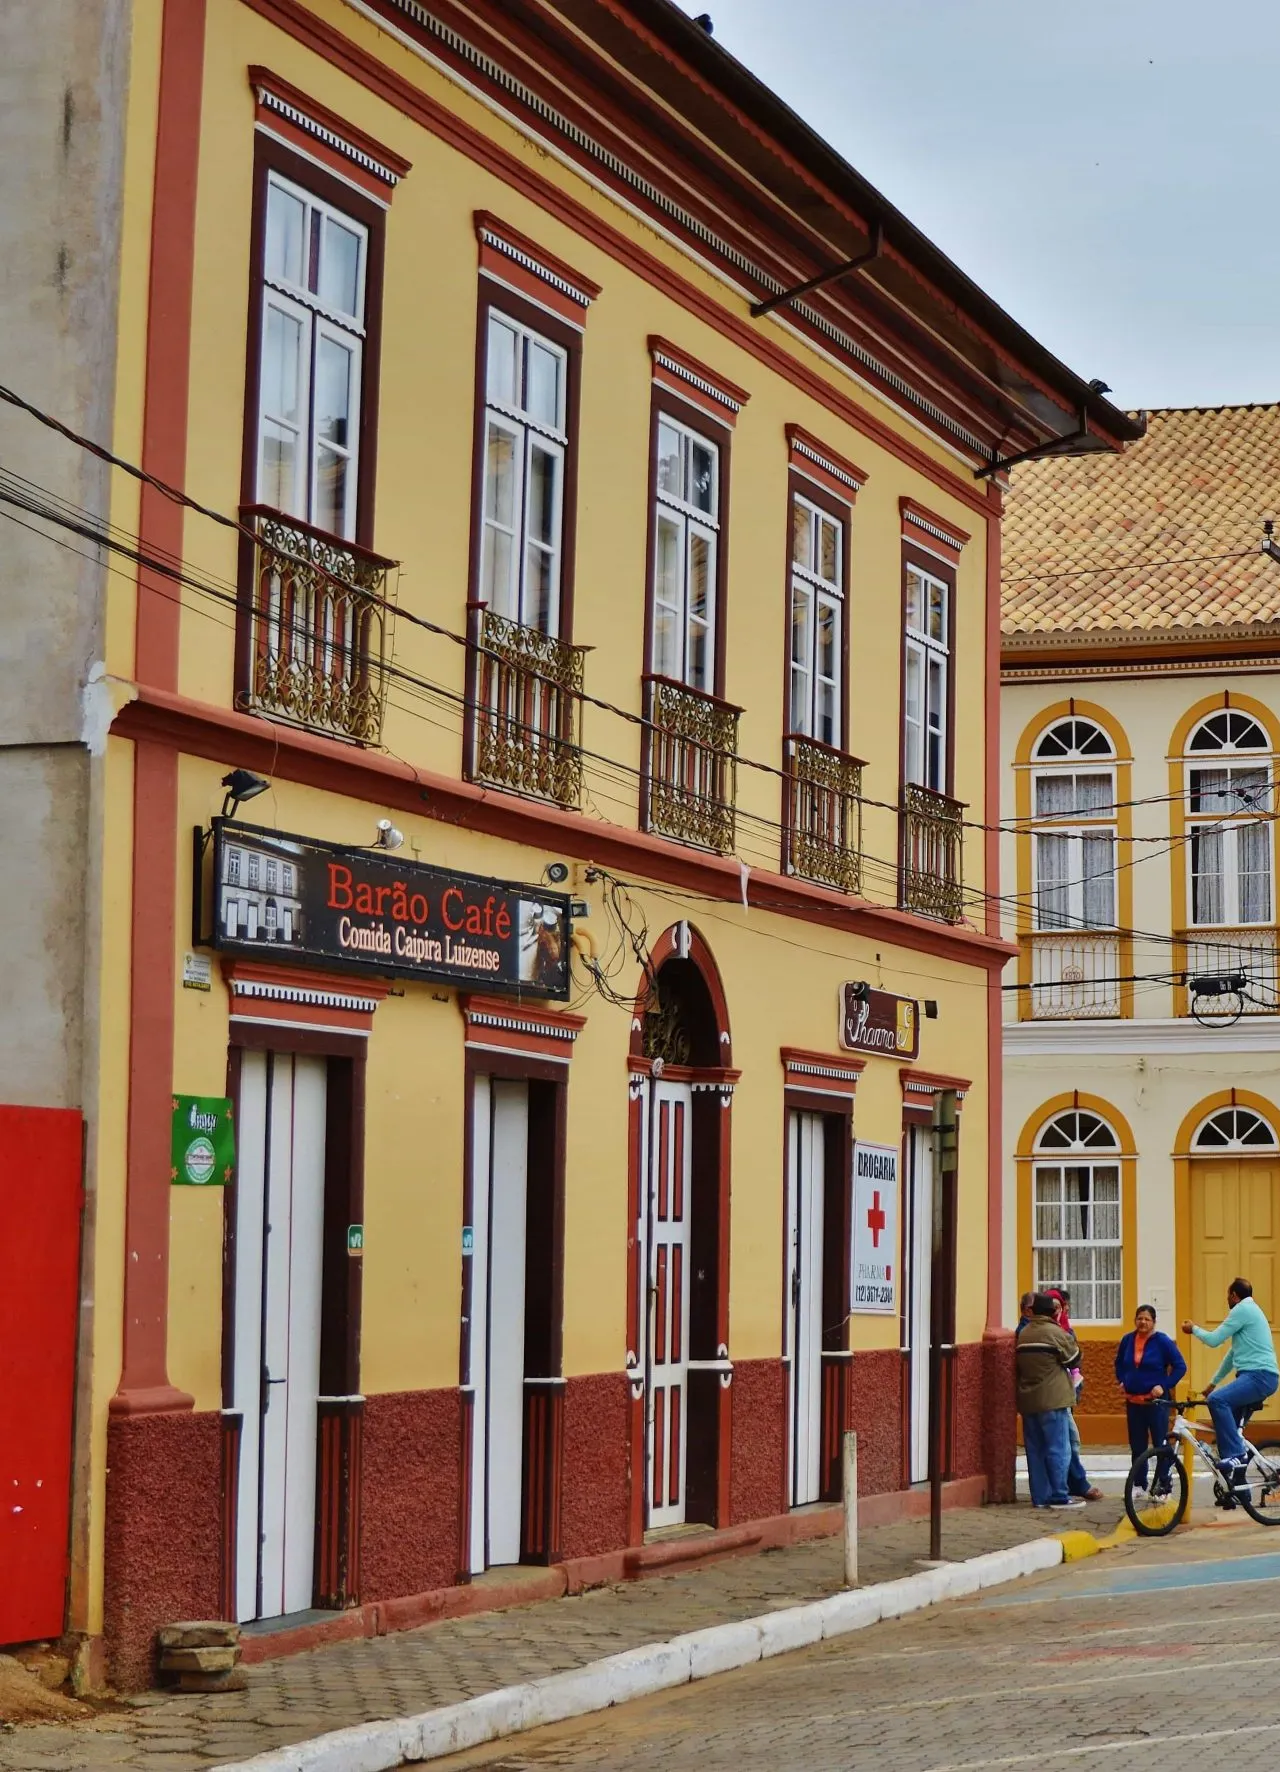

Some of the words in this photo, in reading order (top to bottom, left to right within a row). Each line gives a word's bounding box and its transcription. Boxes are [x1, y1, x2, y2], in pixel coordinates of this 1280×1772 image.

[327, 863, 429, 925] Barão
[441, 887, 512, 940] Café
[339, 916, 392, 954] Comida
[395, 925, 442, 963] Caipira
[445, 935, 500, 972] Luizense
[857, 1151, 896, 1182] DROGARIA
